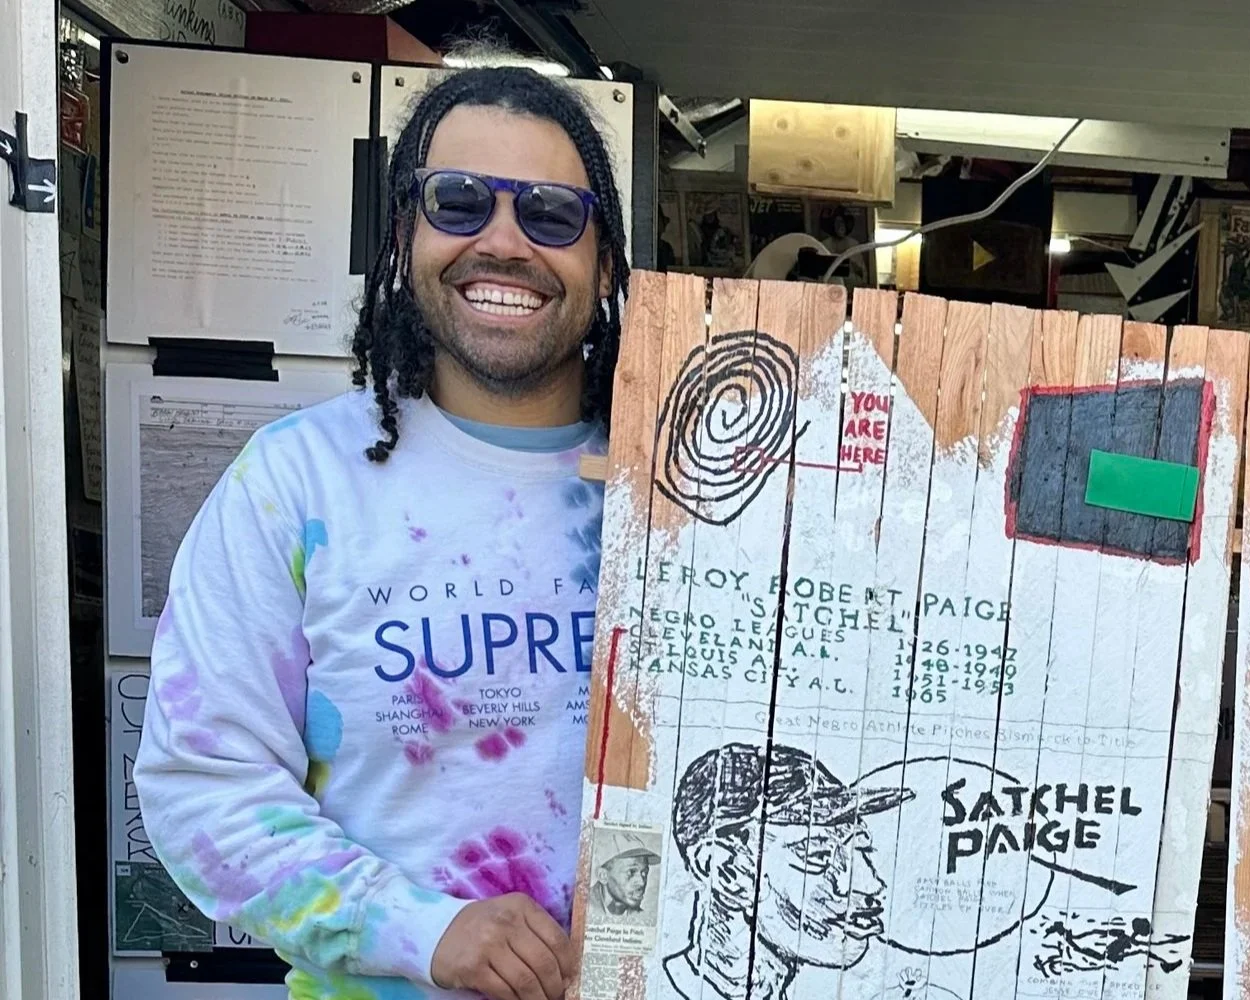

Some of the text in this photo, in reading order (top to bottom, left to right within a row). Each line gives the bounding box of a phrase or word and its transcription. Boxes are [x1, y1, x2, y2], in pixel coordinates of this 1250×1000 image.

[850, 391, 890, 414] YOU
[844, 418, 886, 440] ARE
[841, 444, 885, 465] HERE
[367, 578, 514, 605] WORLD
[635, 556, 1013, 622] LEROY ROBERT PAIGE
[629, 606, 845, 643] NEGRO LEAGUES
[374, 611, 596, 682] SUPRE
[666, 643, 738, 665] LOUIS
[629, 657, 732, 680] KANSAS
[391, 694, 425, 706] PARIS
[479, 687, 522, 700] TOKYO
[375, 708, 444, 722] SHANGHAI
[462, 701, 541, 716] BEVERLY HILLS
[392, 724, 429, 735] ROME
[469, 716, 536, 729] NEW YORK
[941, 777, 1142, 826] SATCHEL
[945, 819, 1101, 874] PAIGE
